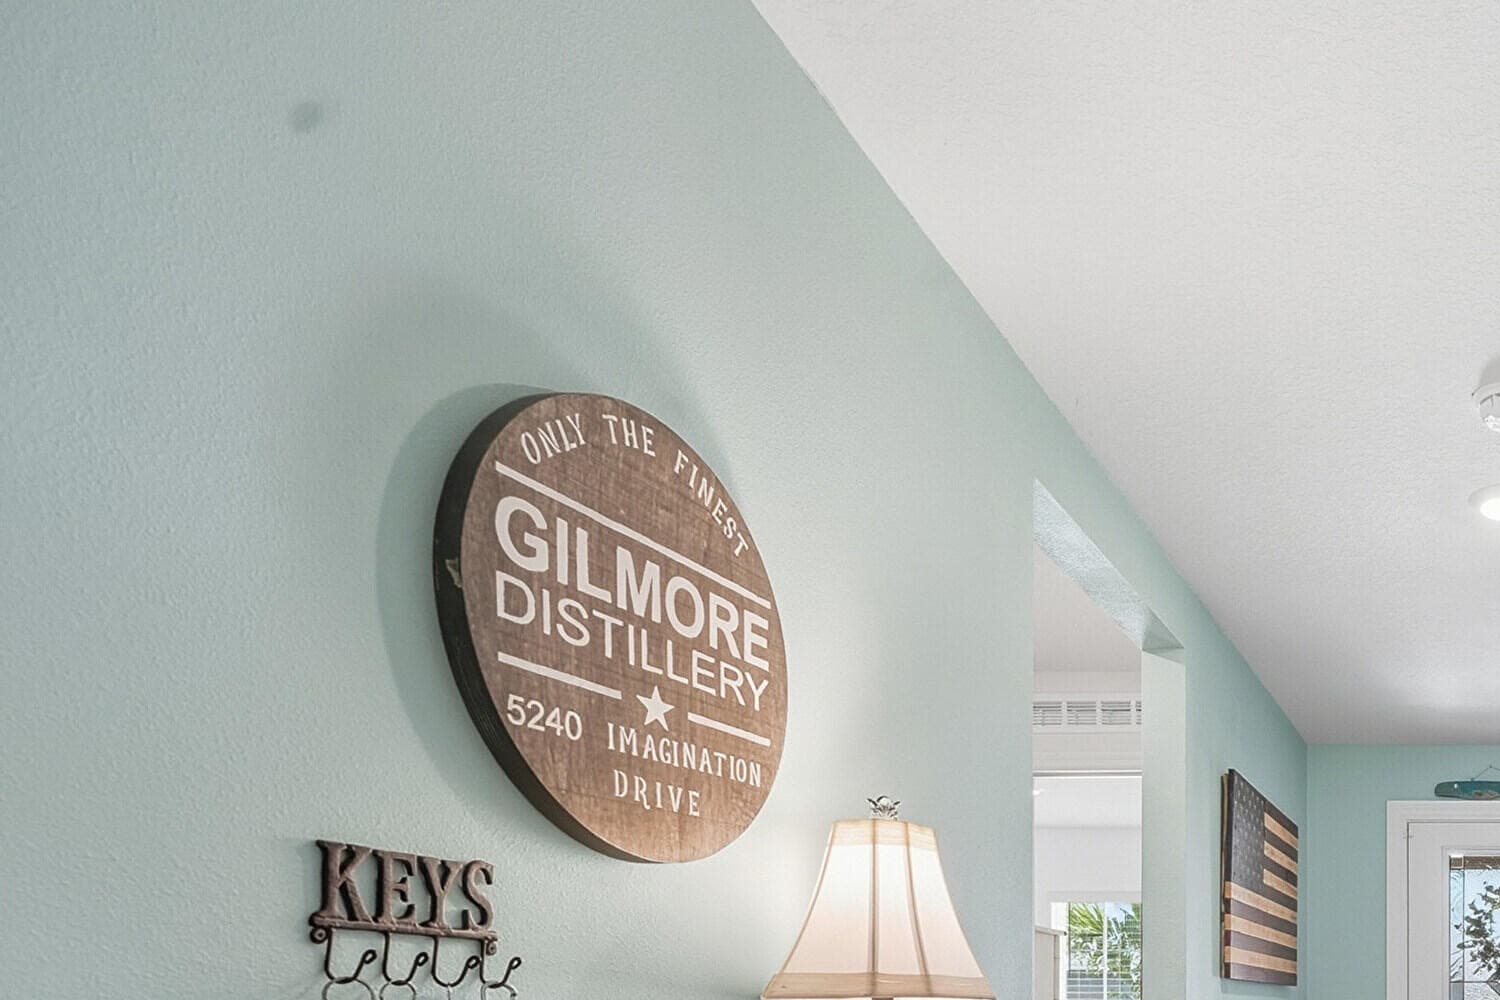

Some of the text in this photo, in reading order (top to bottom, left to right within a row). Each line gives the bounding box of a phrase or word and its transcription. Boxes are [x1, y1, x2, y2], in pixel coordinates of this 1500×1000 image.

[520, 413, 751, 558] ONLY THE FINEST
[495, 495, 770, 672] GILMORE
[495, 570, 770, 712] DISTILLERY
[506, 693, 762, 788] 5240 IMAGINATION
[613, 769, 701, 817] DRIVE
[316, 840, 495, 930] KEYS
